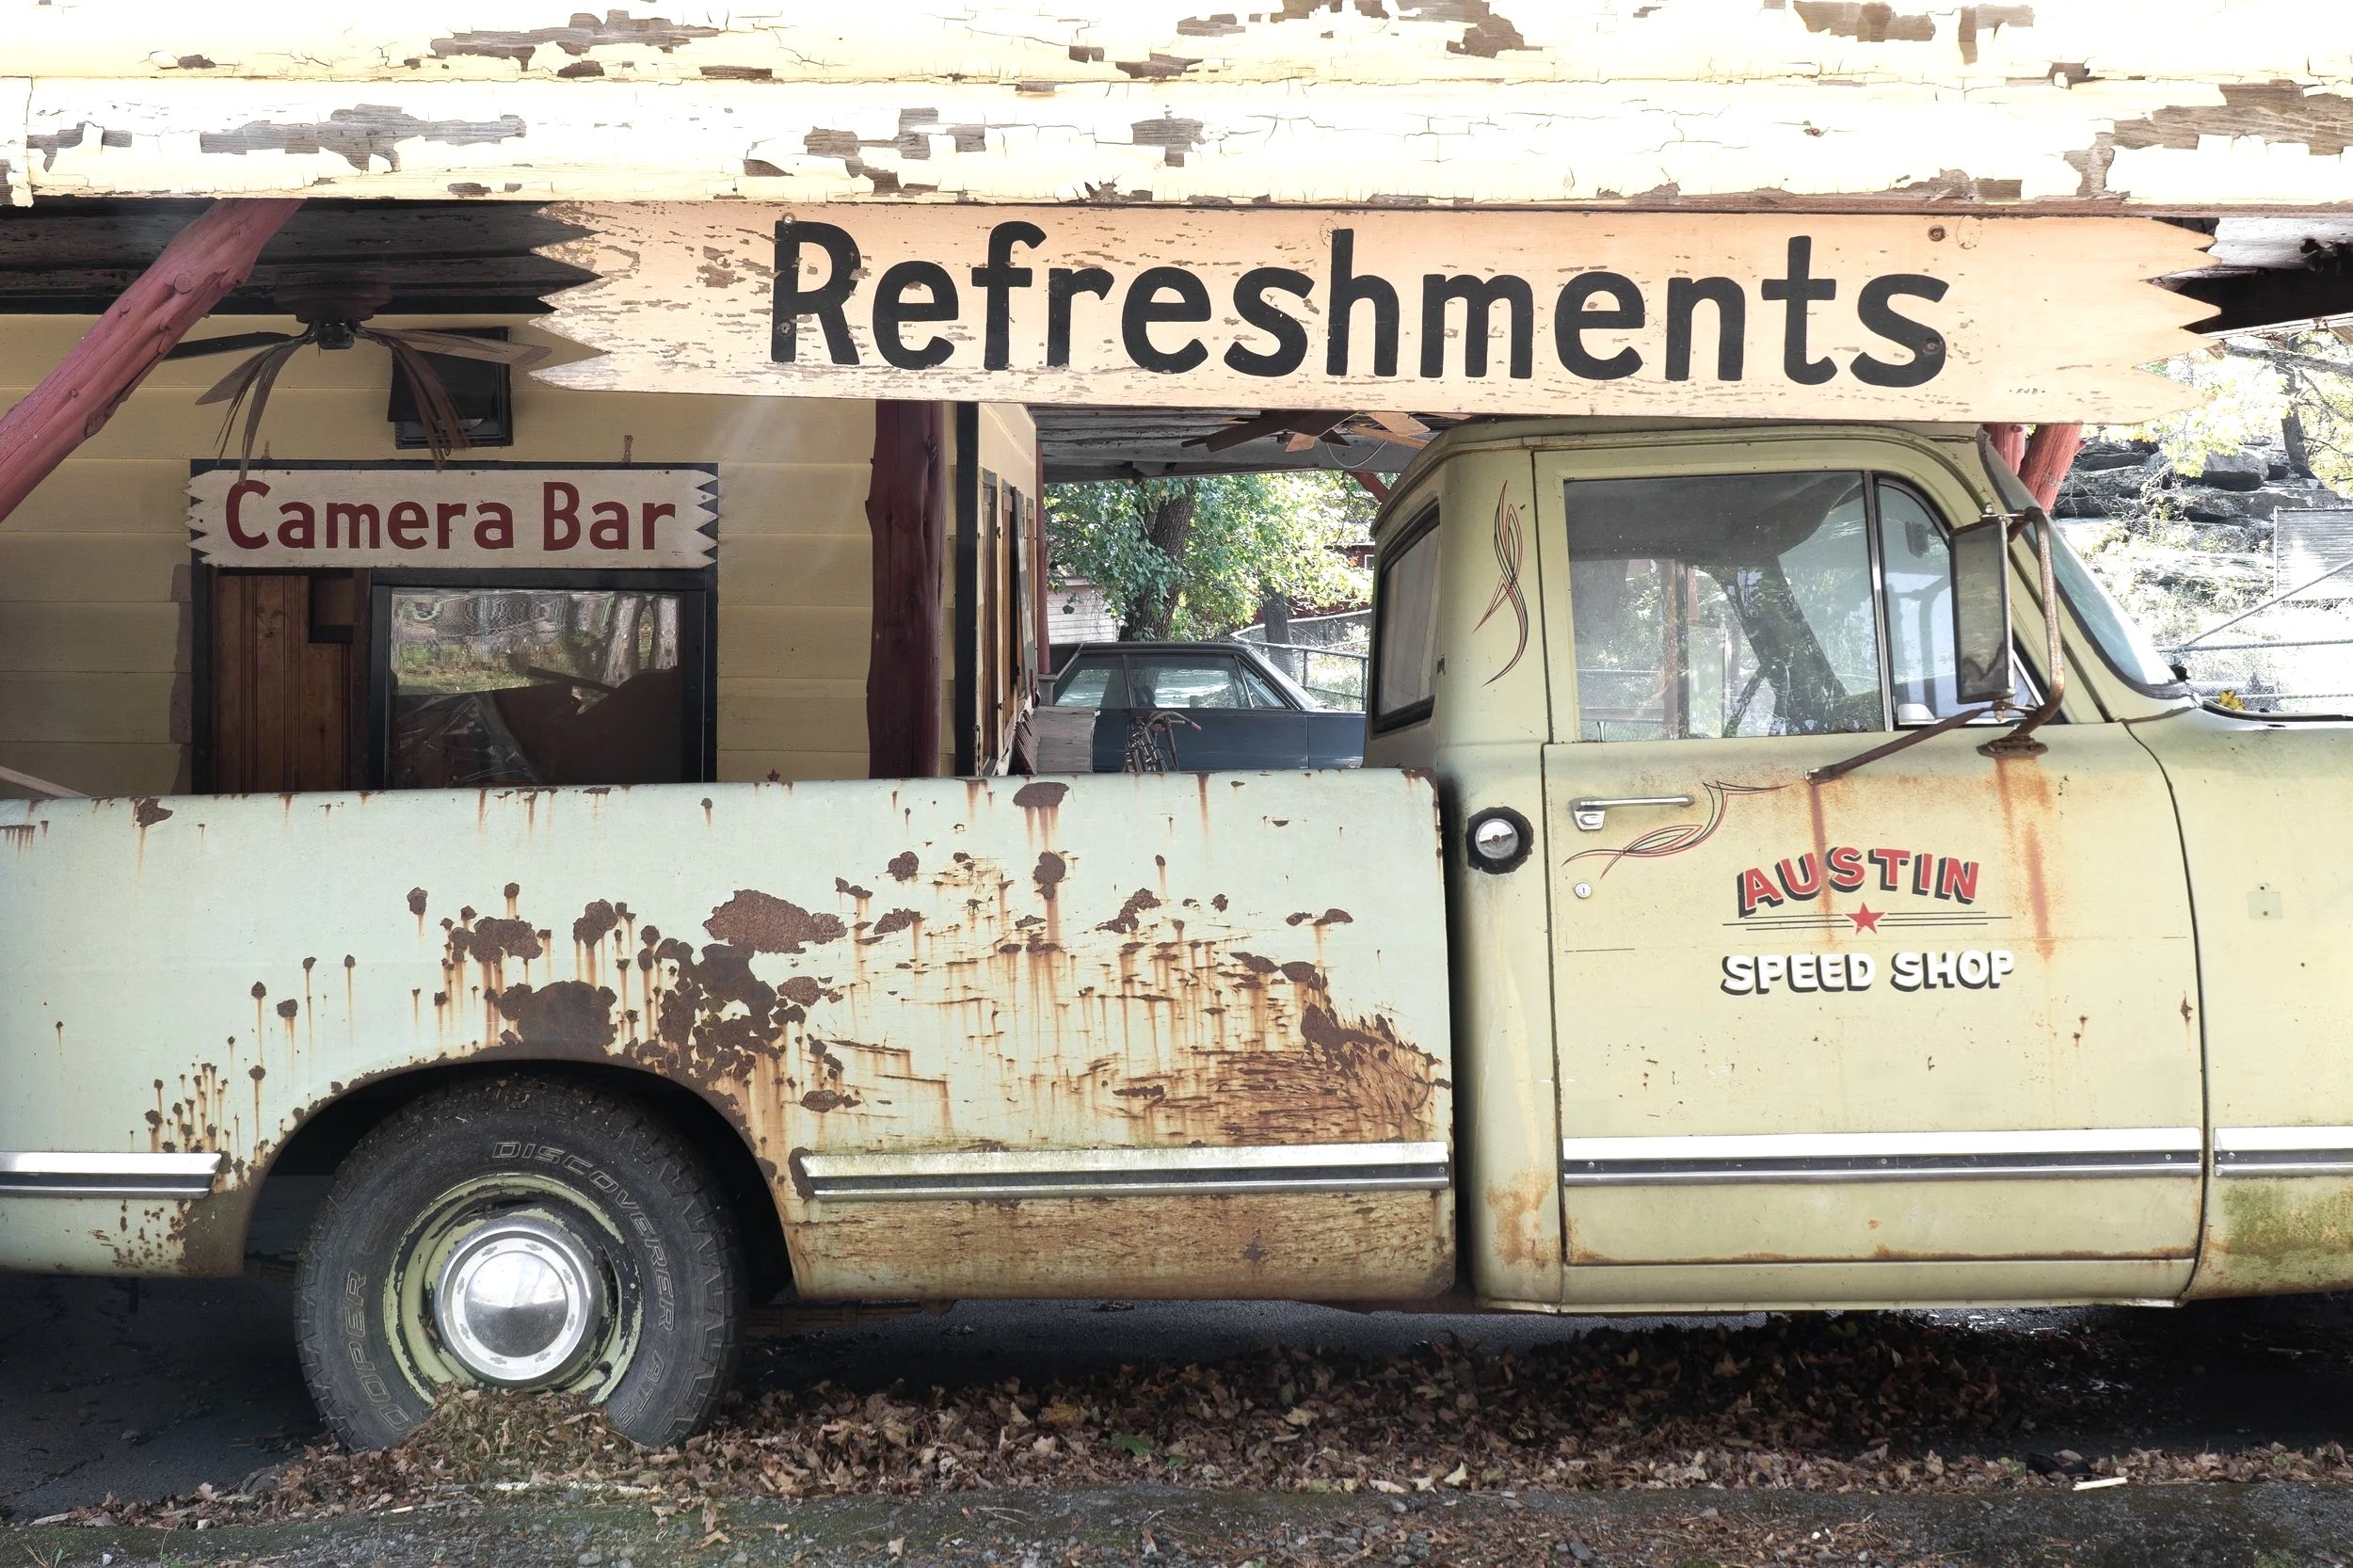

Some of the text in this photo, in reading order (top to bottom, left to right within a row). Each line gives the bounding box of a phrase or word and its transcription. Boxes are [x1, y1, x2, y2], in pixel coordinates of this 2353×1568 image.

[770, 219, 1950, 389] Refreshments
[225, 480, 677, 552] Camera Bar
[1737, 846, 1980, 919] AUSTIN
[1721, 949, 2015, 996] SPEED SHOP
[491, 1142, 676, 1332] DISCOVERER
[345, 1271, 414, 1432] OOPER
